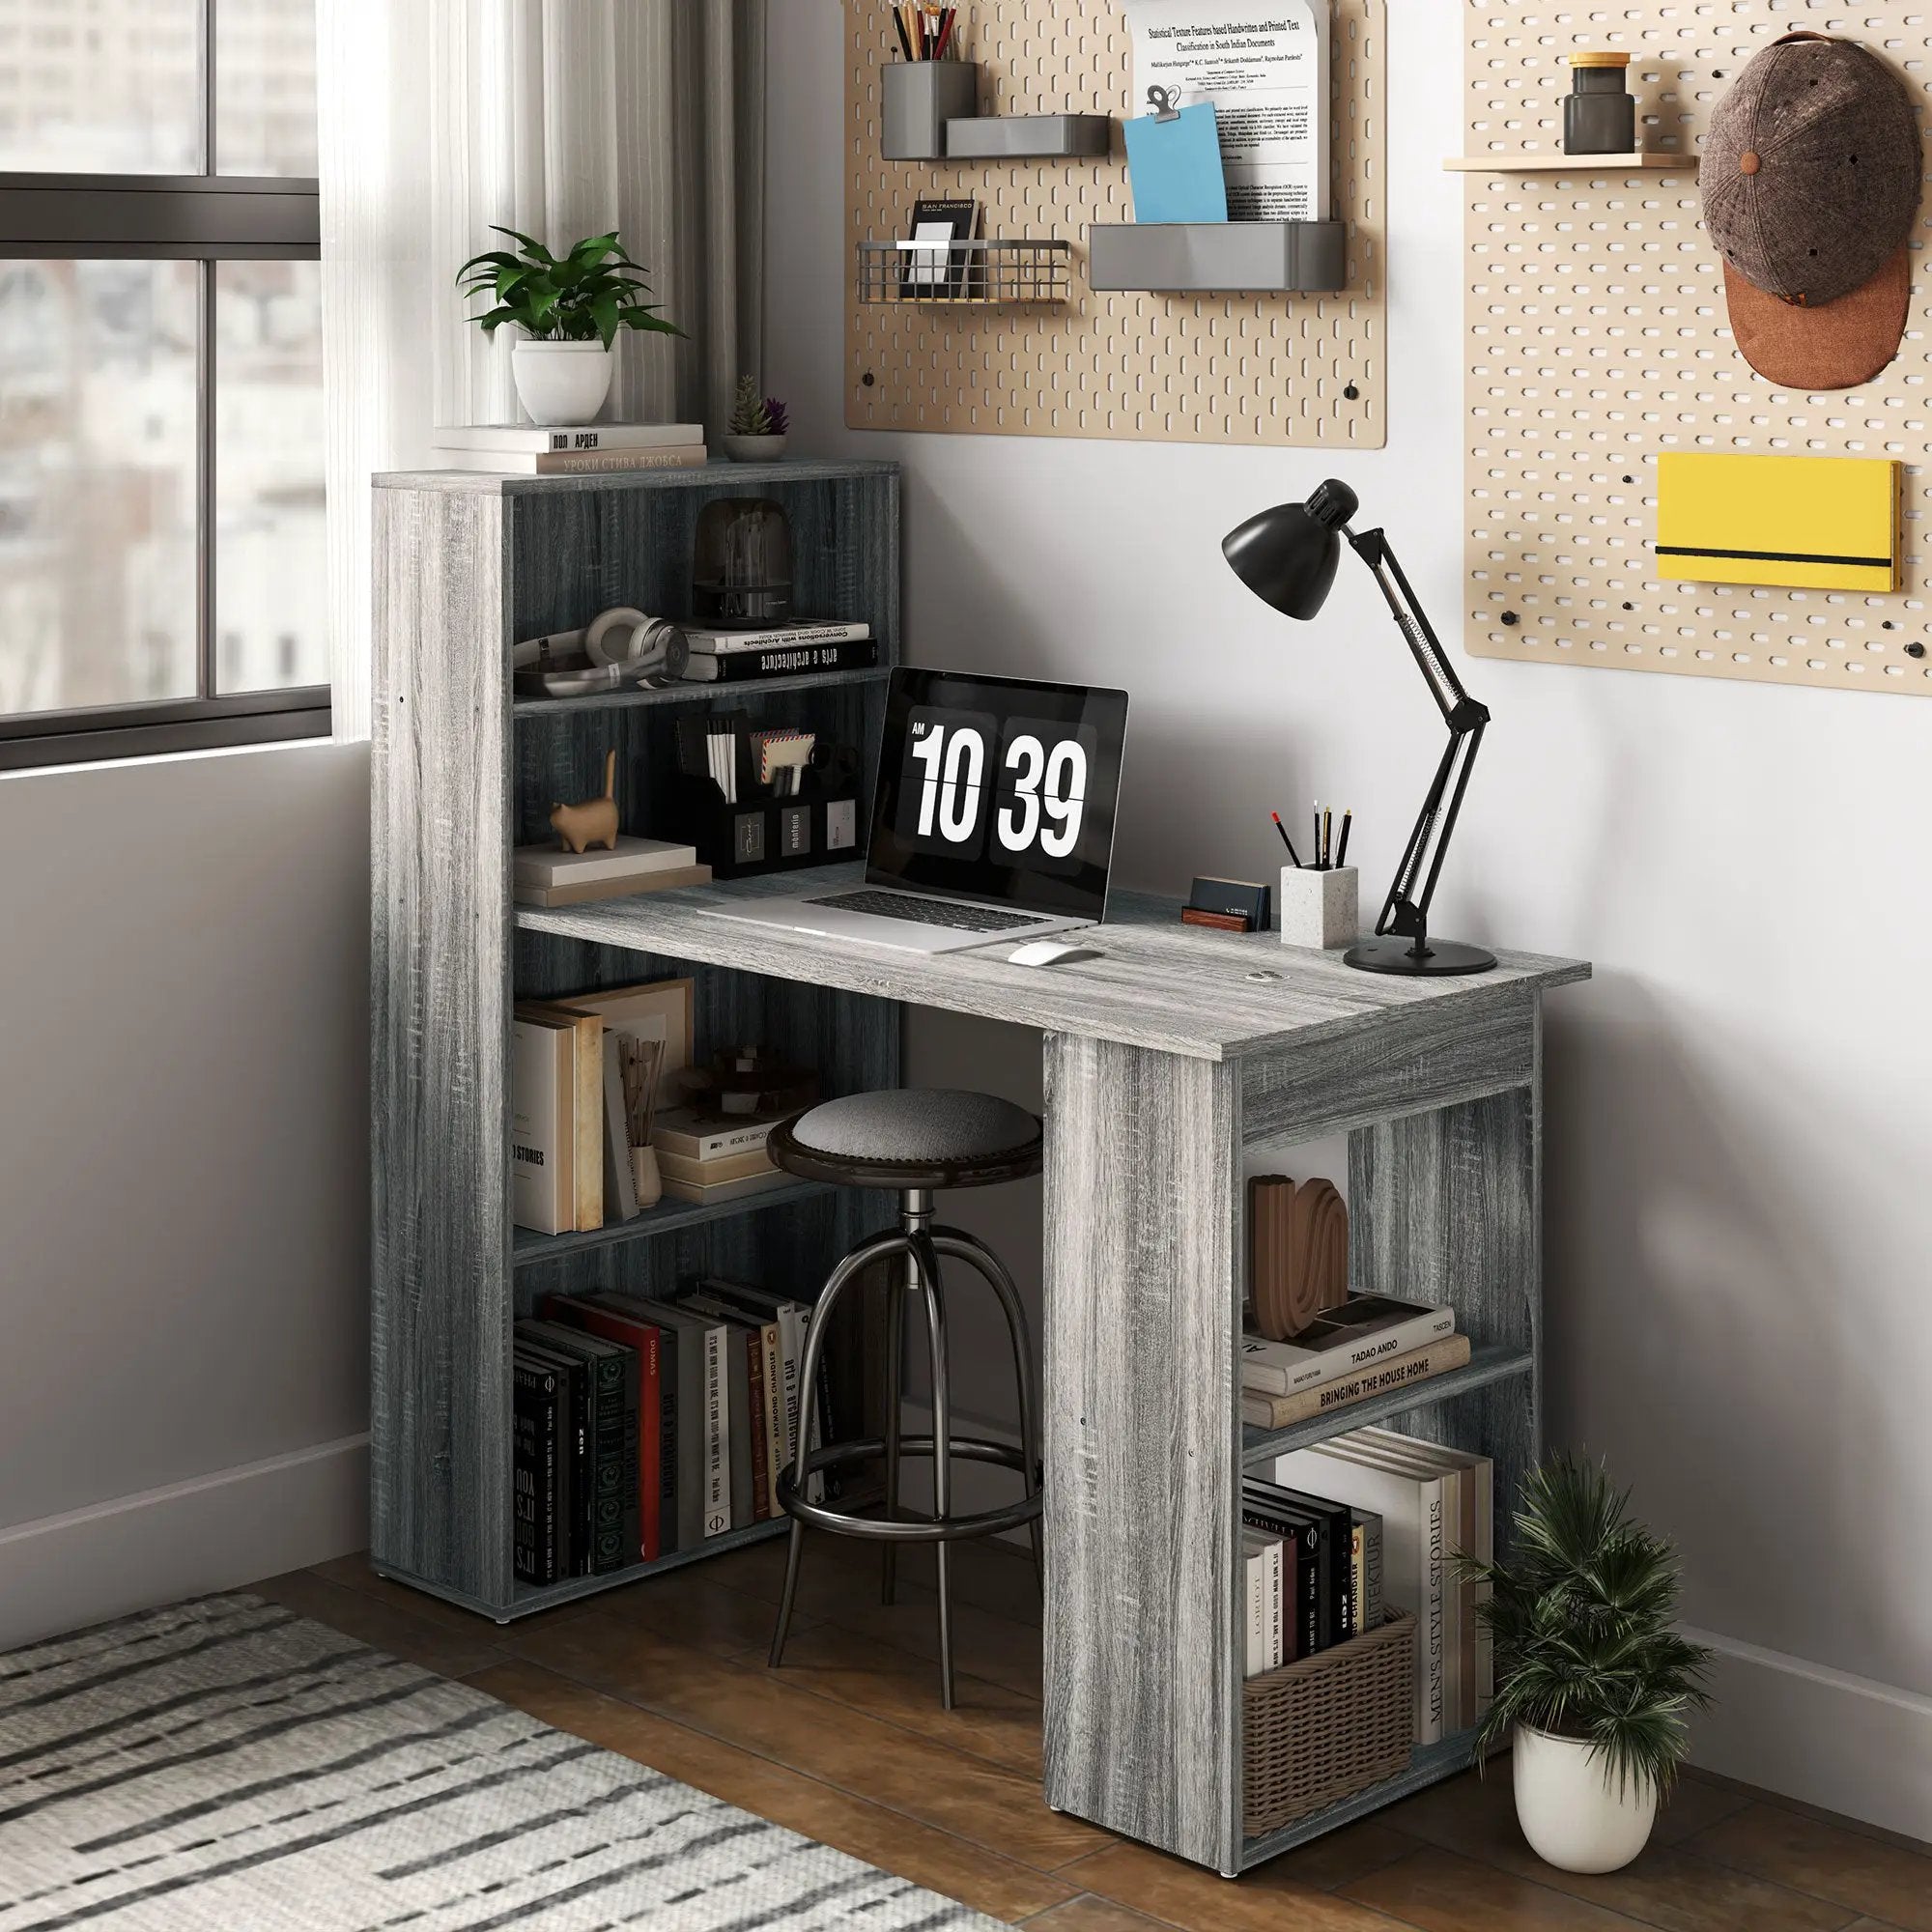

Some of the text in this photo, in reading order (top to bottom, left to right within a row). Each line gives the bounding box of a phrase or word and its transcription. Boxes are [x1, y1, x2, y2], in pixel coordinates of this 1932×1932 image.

[1149, 19, 1299, 39] Statistical Texture Features based Handwritten and Printed Text
[1177, 39, 1275, 51] Classification in South Indian Documents
[554, 434, 598, 448] ПОЛ АРДЕН
[564, 455, 682, 472] УРОКИ СТИВА ДЖОБСА
[744, 638, 780, 646] Architects
[798, 632, 848, 641] Conversations
[761, 651, 810, 670] architecture
[822, 648, 838, 665] arts
[912, 723, 924, 735] AM
[912, 724, 1087, 858] 10 39
[517, 1146, 544, 1166] STORIES
[1351, 1339, 1397, 1364] TADAO ANDO
[784, 1359, 796, 1380] arts
[1321, 1358, 1429, 1407] BRINGING THE HOUSE HOME
[1430, 1500, 1441, 1724] MEN'S STYLE STORIES
[1310, 1620, 1315, 1629] TO
